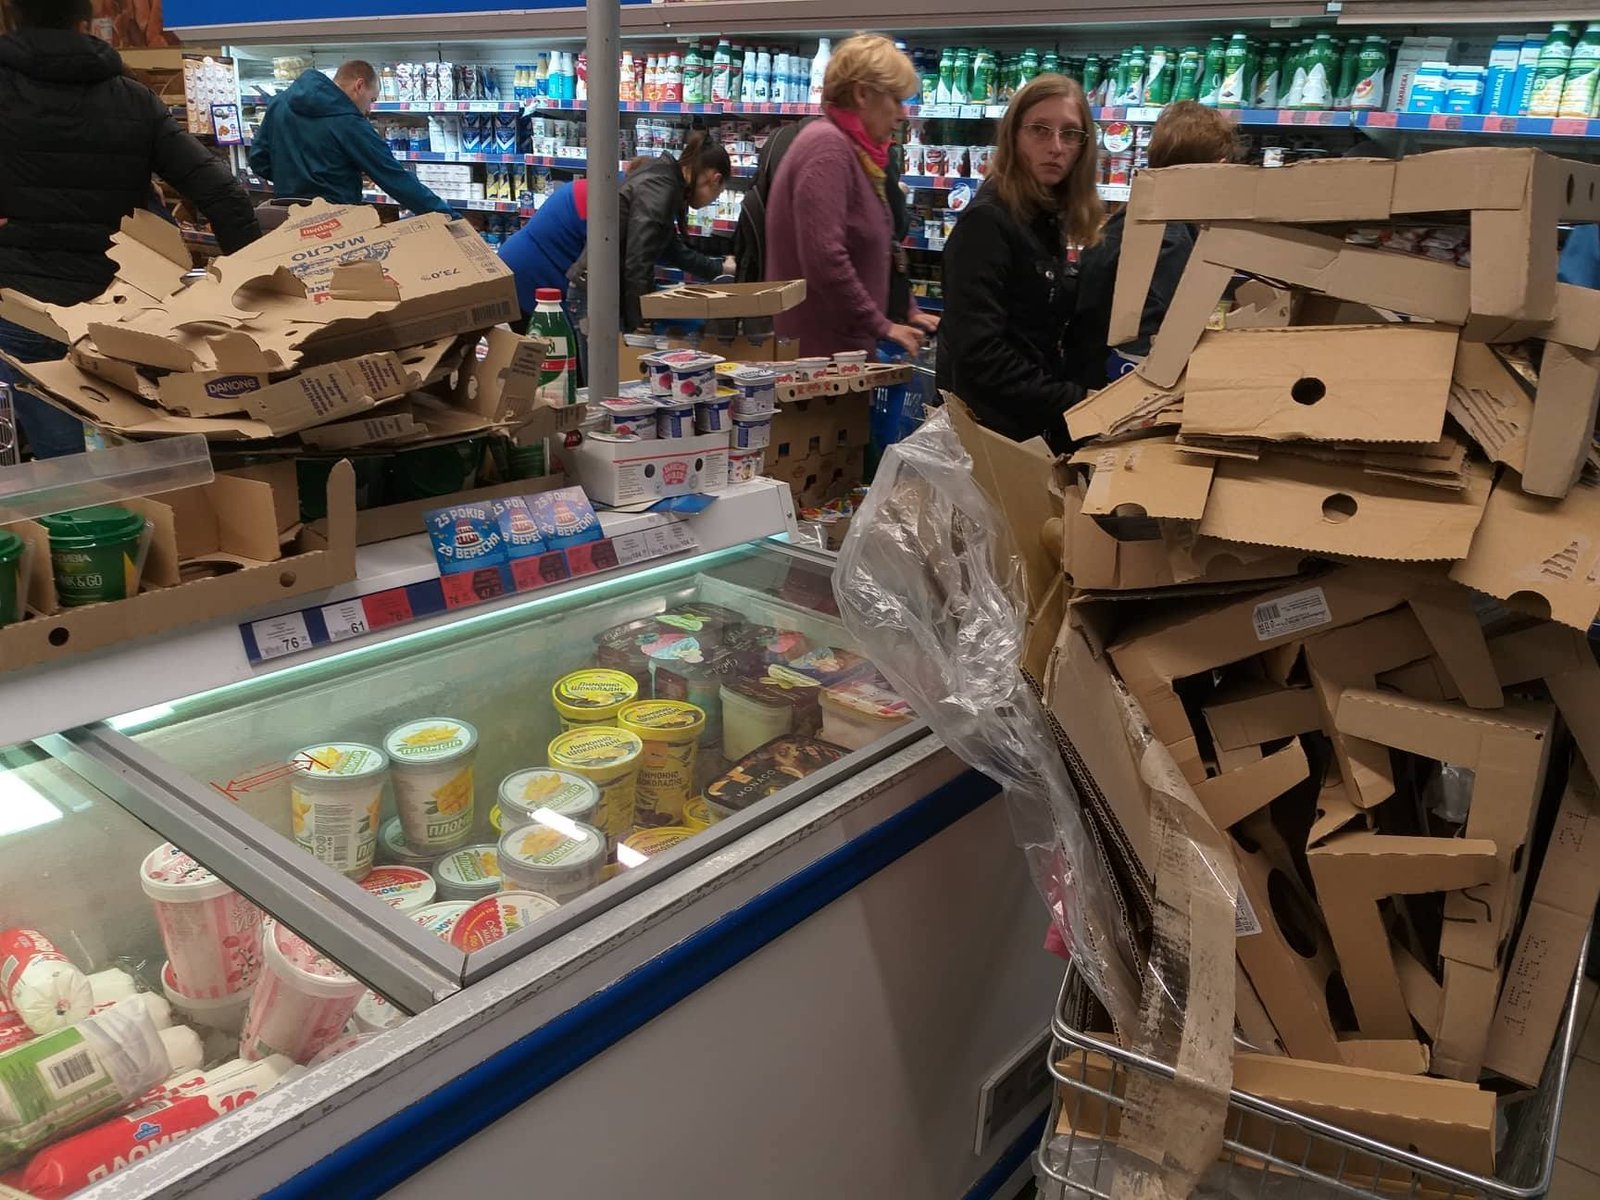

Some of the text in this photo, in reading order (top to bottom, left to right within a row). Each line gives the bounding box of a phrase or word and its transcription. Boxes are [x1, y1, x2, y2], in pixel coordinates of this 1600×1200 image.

[291, 235, 366, 262] МАСЛО
[434, 507, 486, 528] 25 РОКІВ
[541, 521, 555, 534] 29
[437, 533, 501, 560] 29 ВЕРЕСНЯ
[350, 620, 365, 634] 61
[282, 637, 300, 651] 76
[735, 769, 778, 799] MONACO
